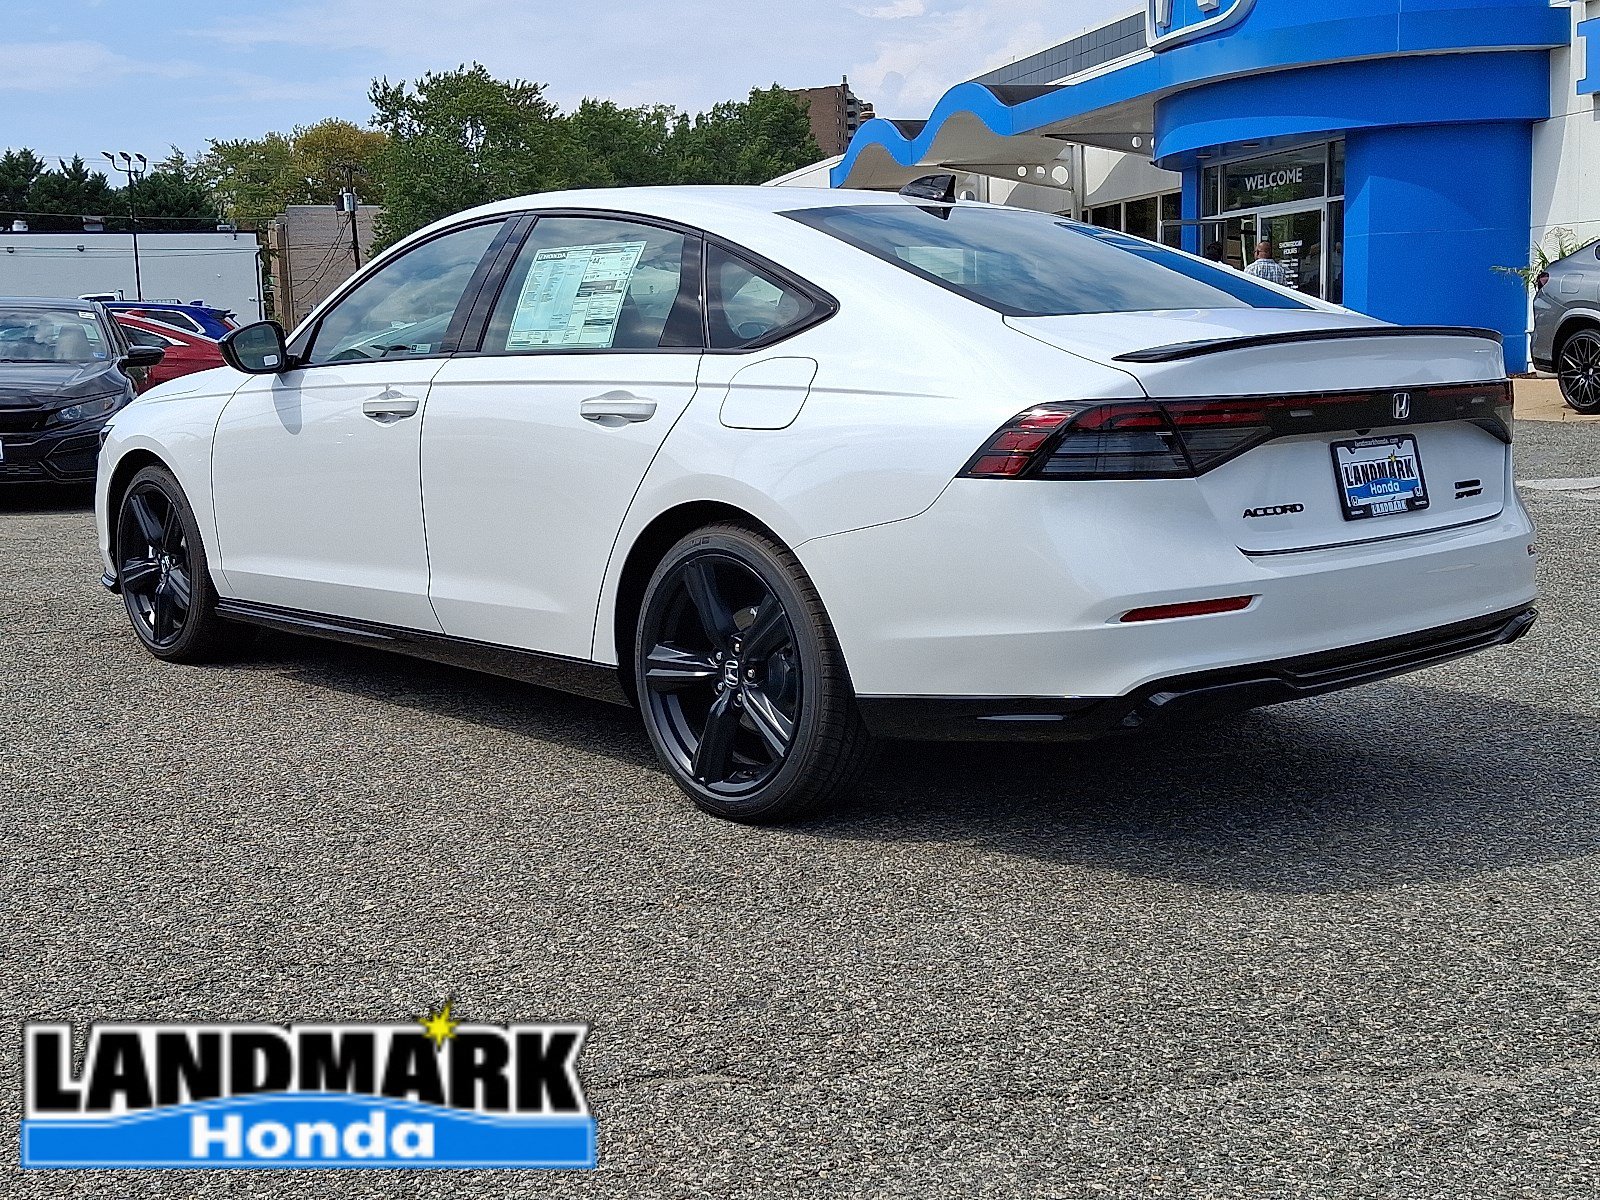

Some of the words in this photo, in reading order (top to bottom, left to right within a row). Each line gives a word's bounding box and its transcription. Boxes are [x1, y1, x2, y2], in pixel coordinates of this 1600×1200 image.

[1244, 167, 1303, 192] WELCOME
[1343, 458, 1416, 487] LANDMARK
[1369, 480, 1401, 495] Honda
[1242, 503, 1305, 519] ACCORD
